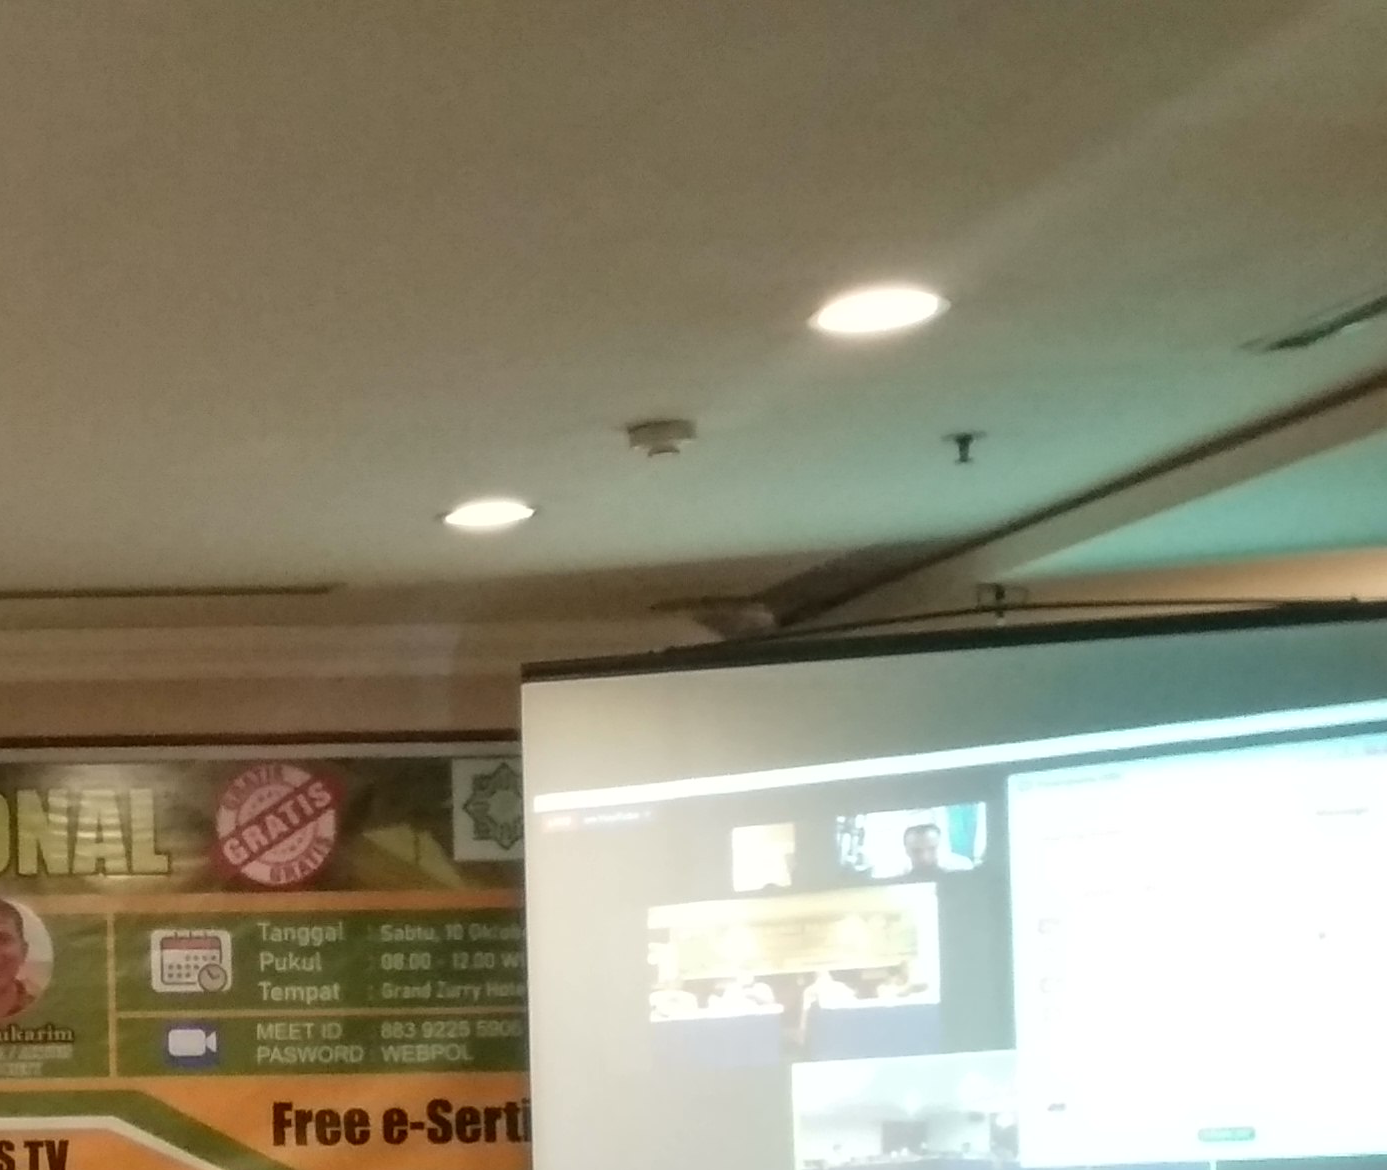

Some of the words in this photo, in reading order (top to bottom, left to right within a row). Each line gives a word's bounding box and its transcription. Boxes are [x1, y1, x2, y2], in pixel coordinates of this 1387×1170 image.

[223, 781, 332, 866] GRATIS
[258, 922, 343, 946] Tanggal
[259, 952, 322, 972] Pukul
[258, 980, 341, 1004] Tempat
[256, 1022, 314, 1041] MEET
[322, 1022, 343, 1040] ID
[256, 1045, 364, 1064] PASWORD
[380, 1044, 474, 1063] WEBPOL
[272, 1101, 371, 1146] Free
[382, 1097, 531, 1145] e-Serti
